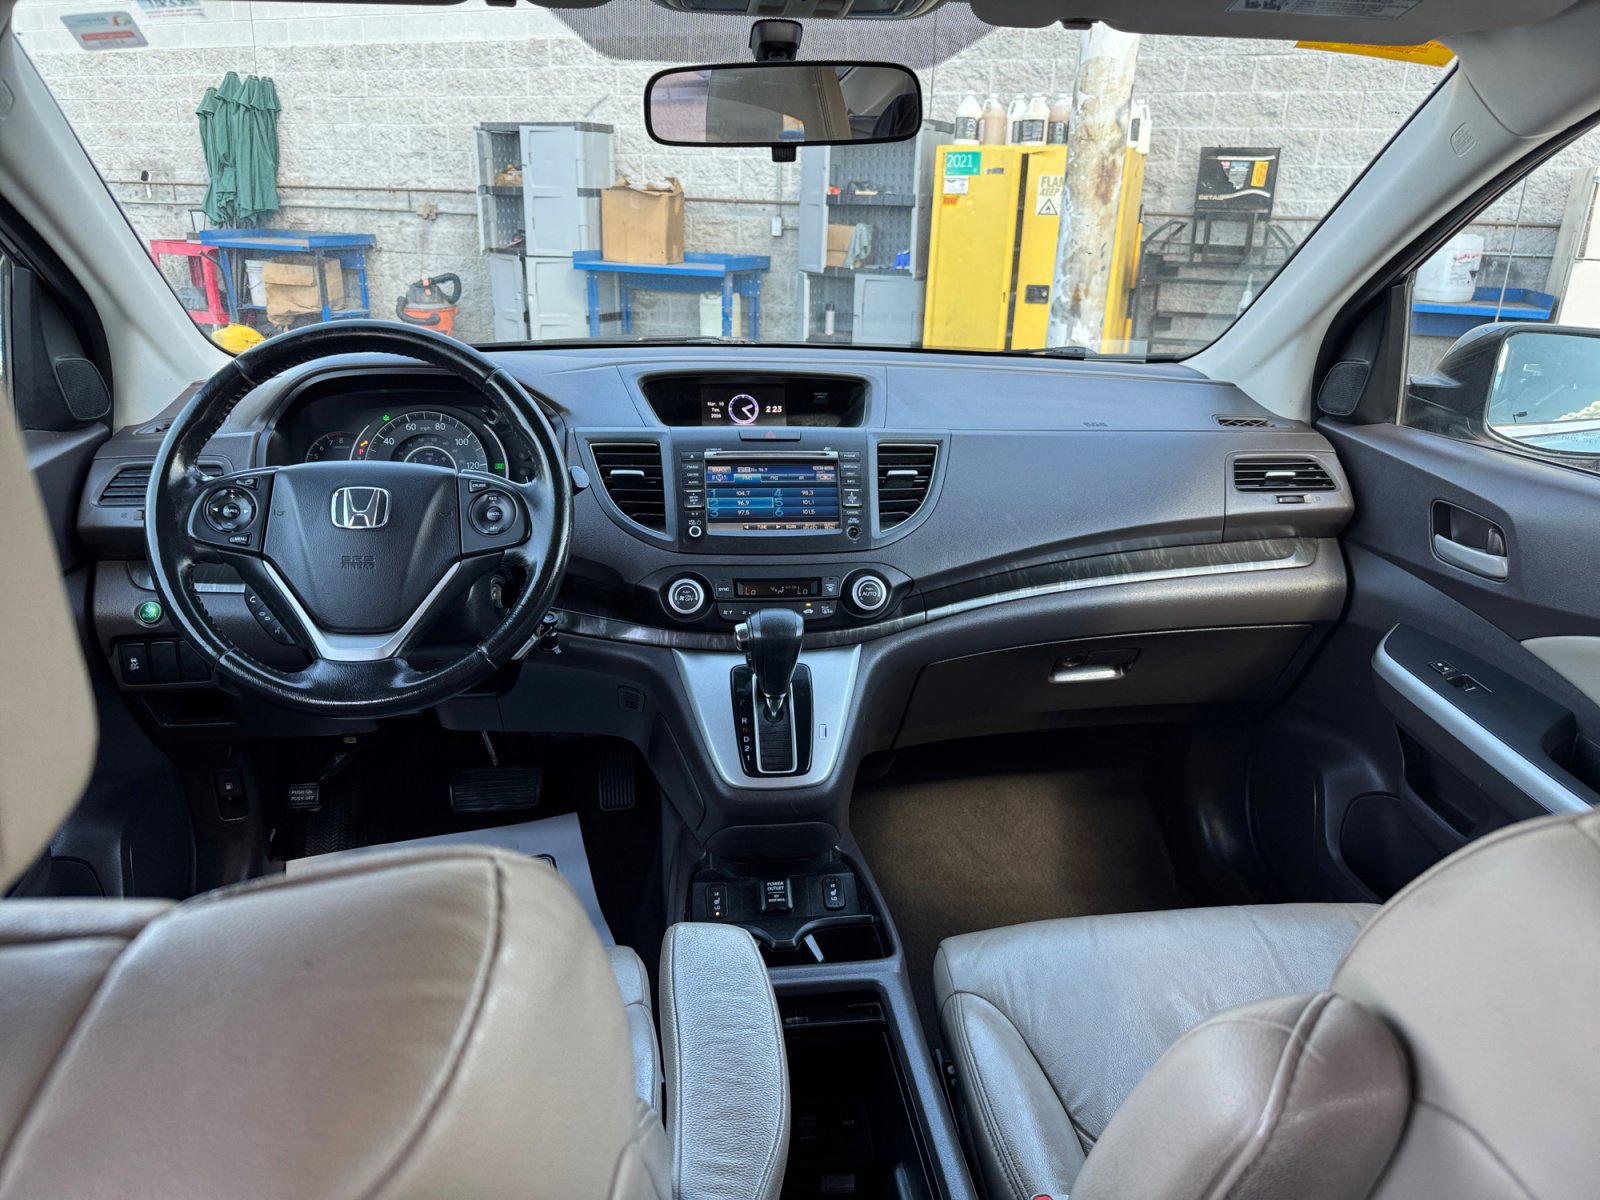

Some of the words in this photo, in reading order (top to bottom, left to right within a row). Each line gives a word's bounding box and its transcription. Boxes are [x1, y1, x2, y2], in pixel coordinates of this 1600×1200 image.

[947, 154, 973, 168] 2021
[405, 422, 417, 431] 60
[435, 422, 446, 431] 80
[383, 437, 395, 446] 40
[455, 438, 469, 446] 100
[466, 461, 480, 470] 120
[775, 507, 784, 517] 6
